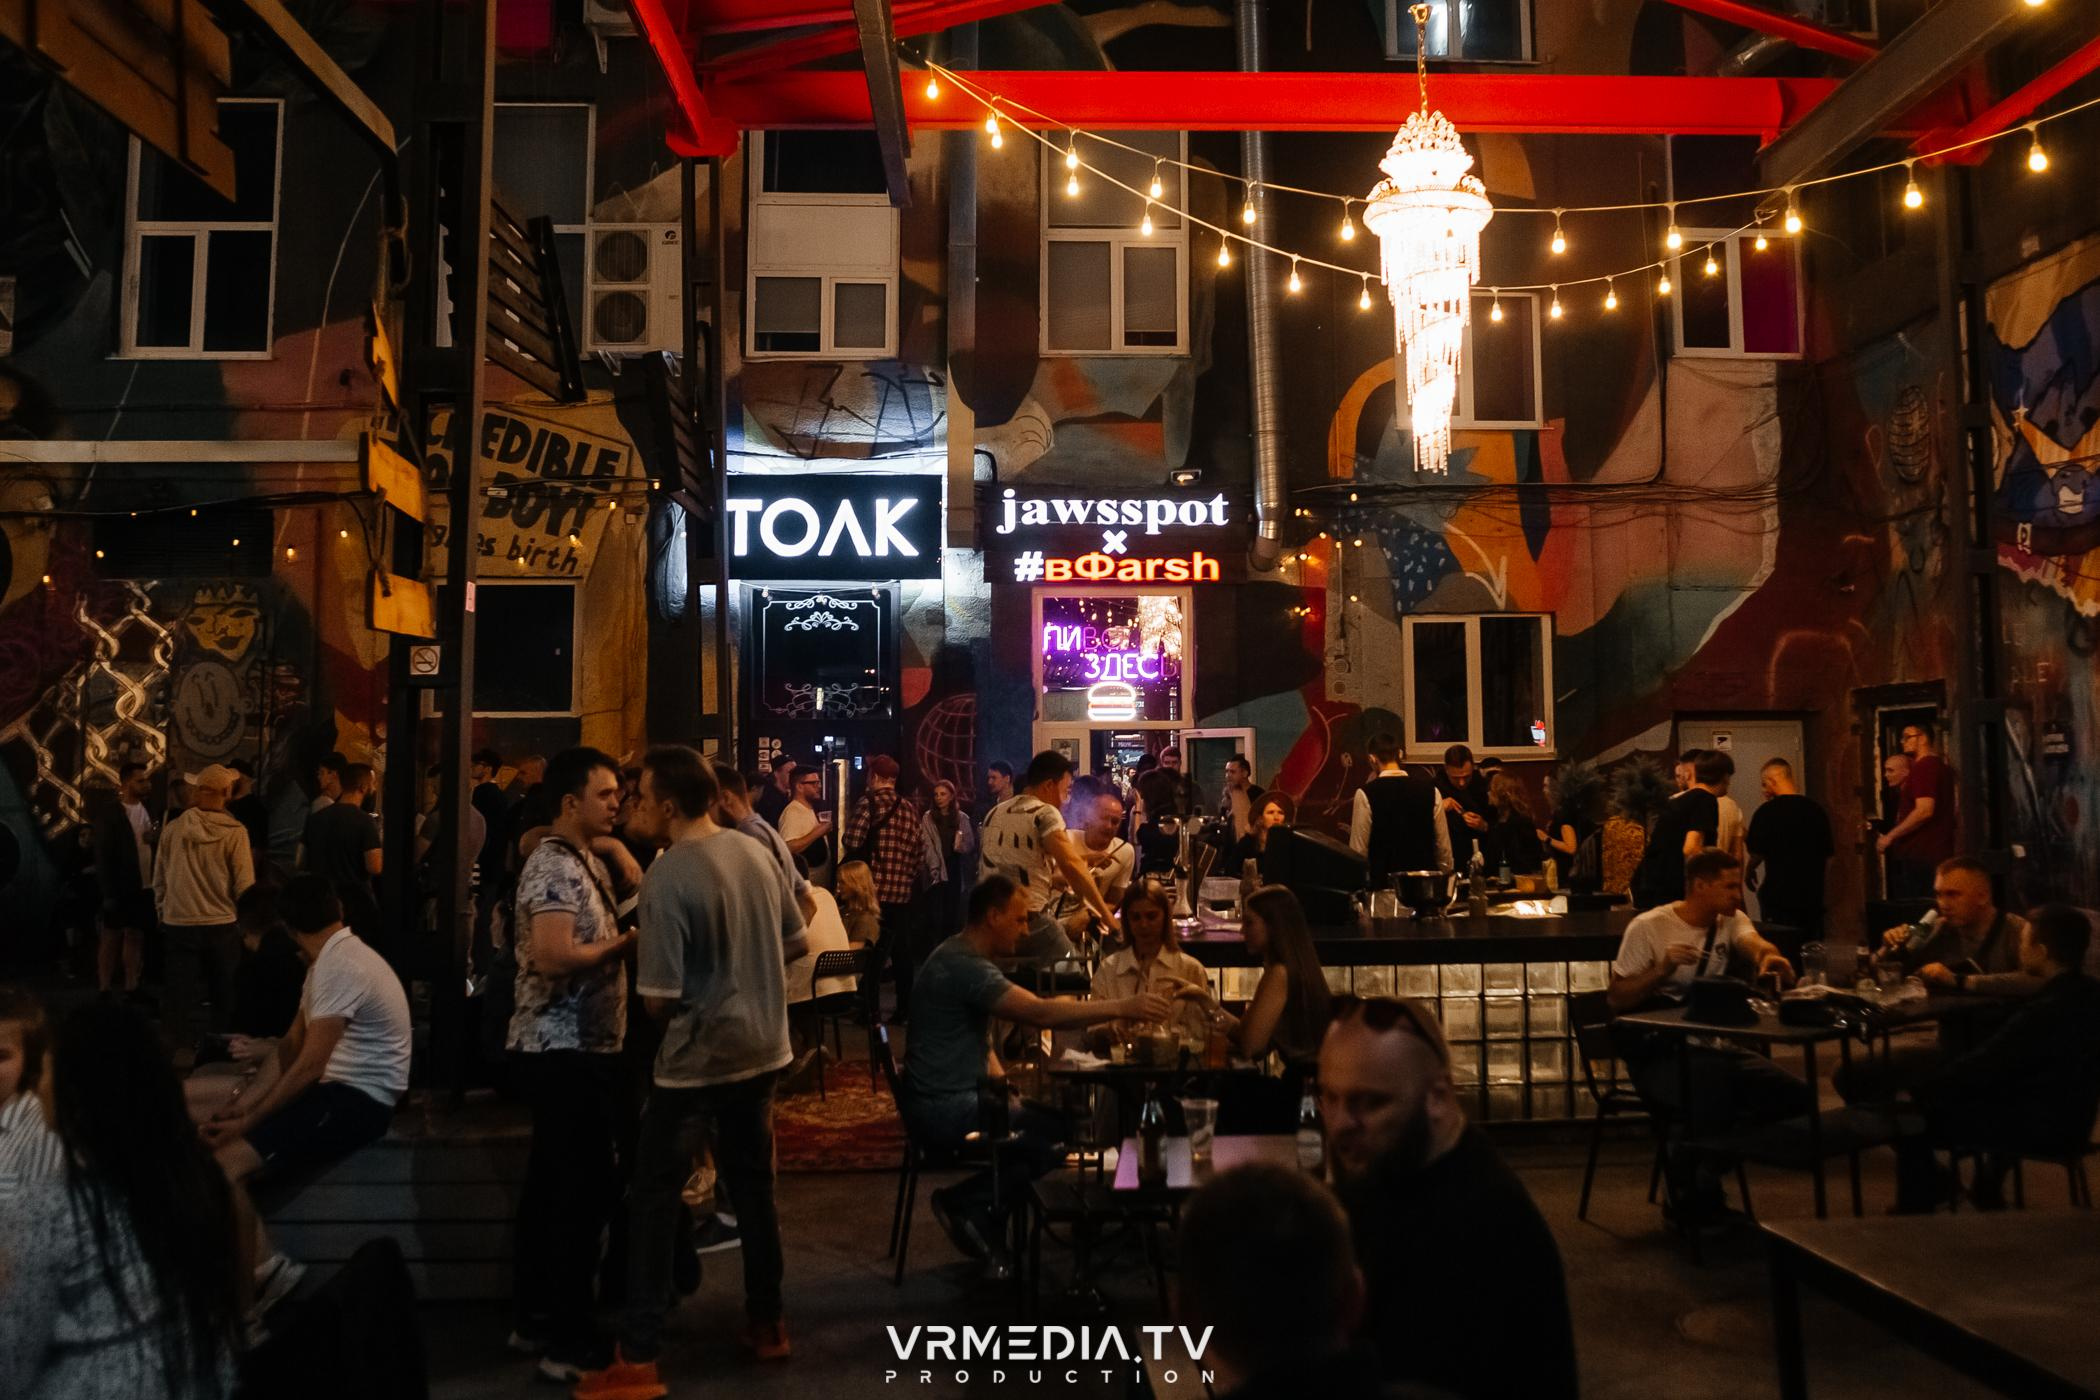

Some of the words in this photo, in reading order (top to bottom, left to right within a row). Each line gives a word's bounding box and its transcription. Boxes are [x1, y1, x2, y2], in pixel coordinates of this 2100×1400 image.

[996, 488, 1230, 535] jawsspot
[507, 533, 579, 573] birth
[1084, 652, 1178, 681] ЗДЕСЬ
